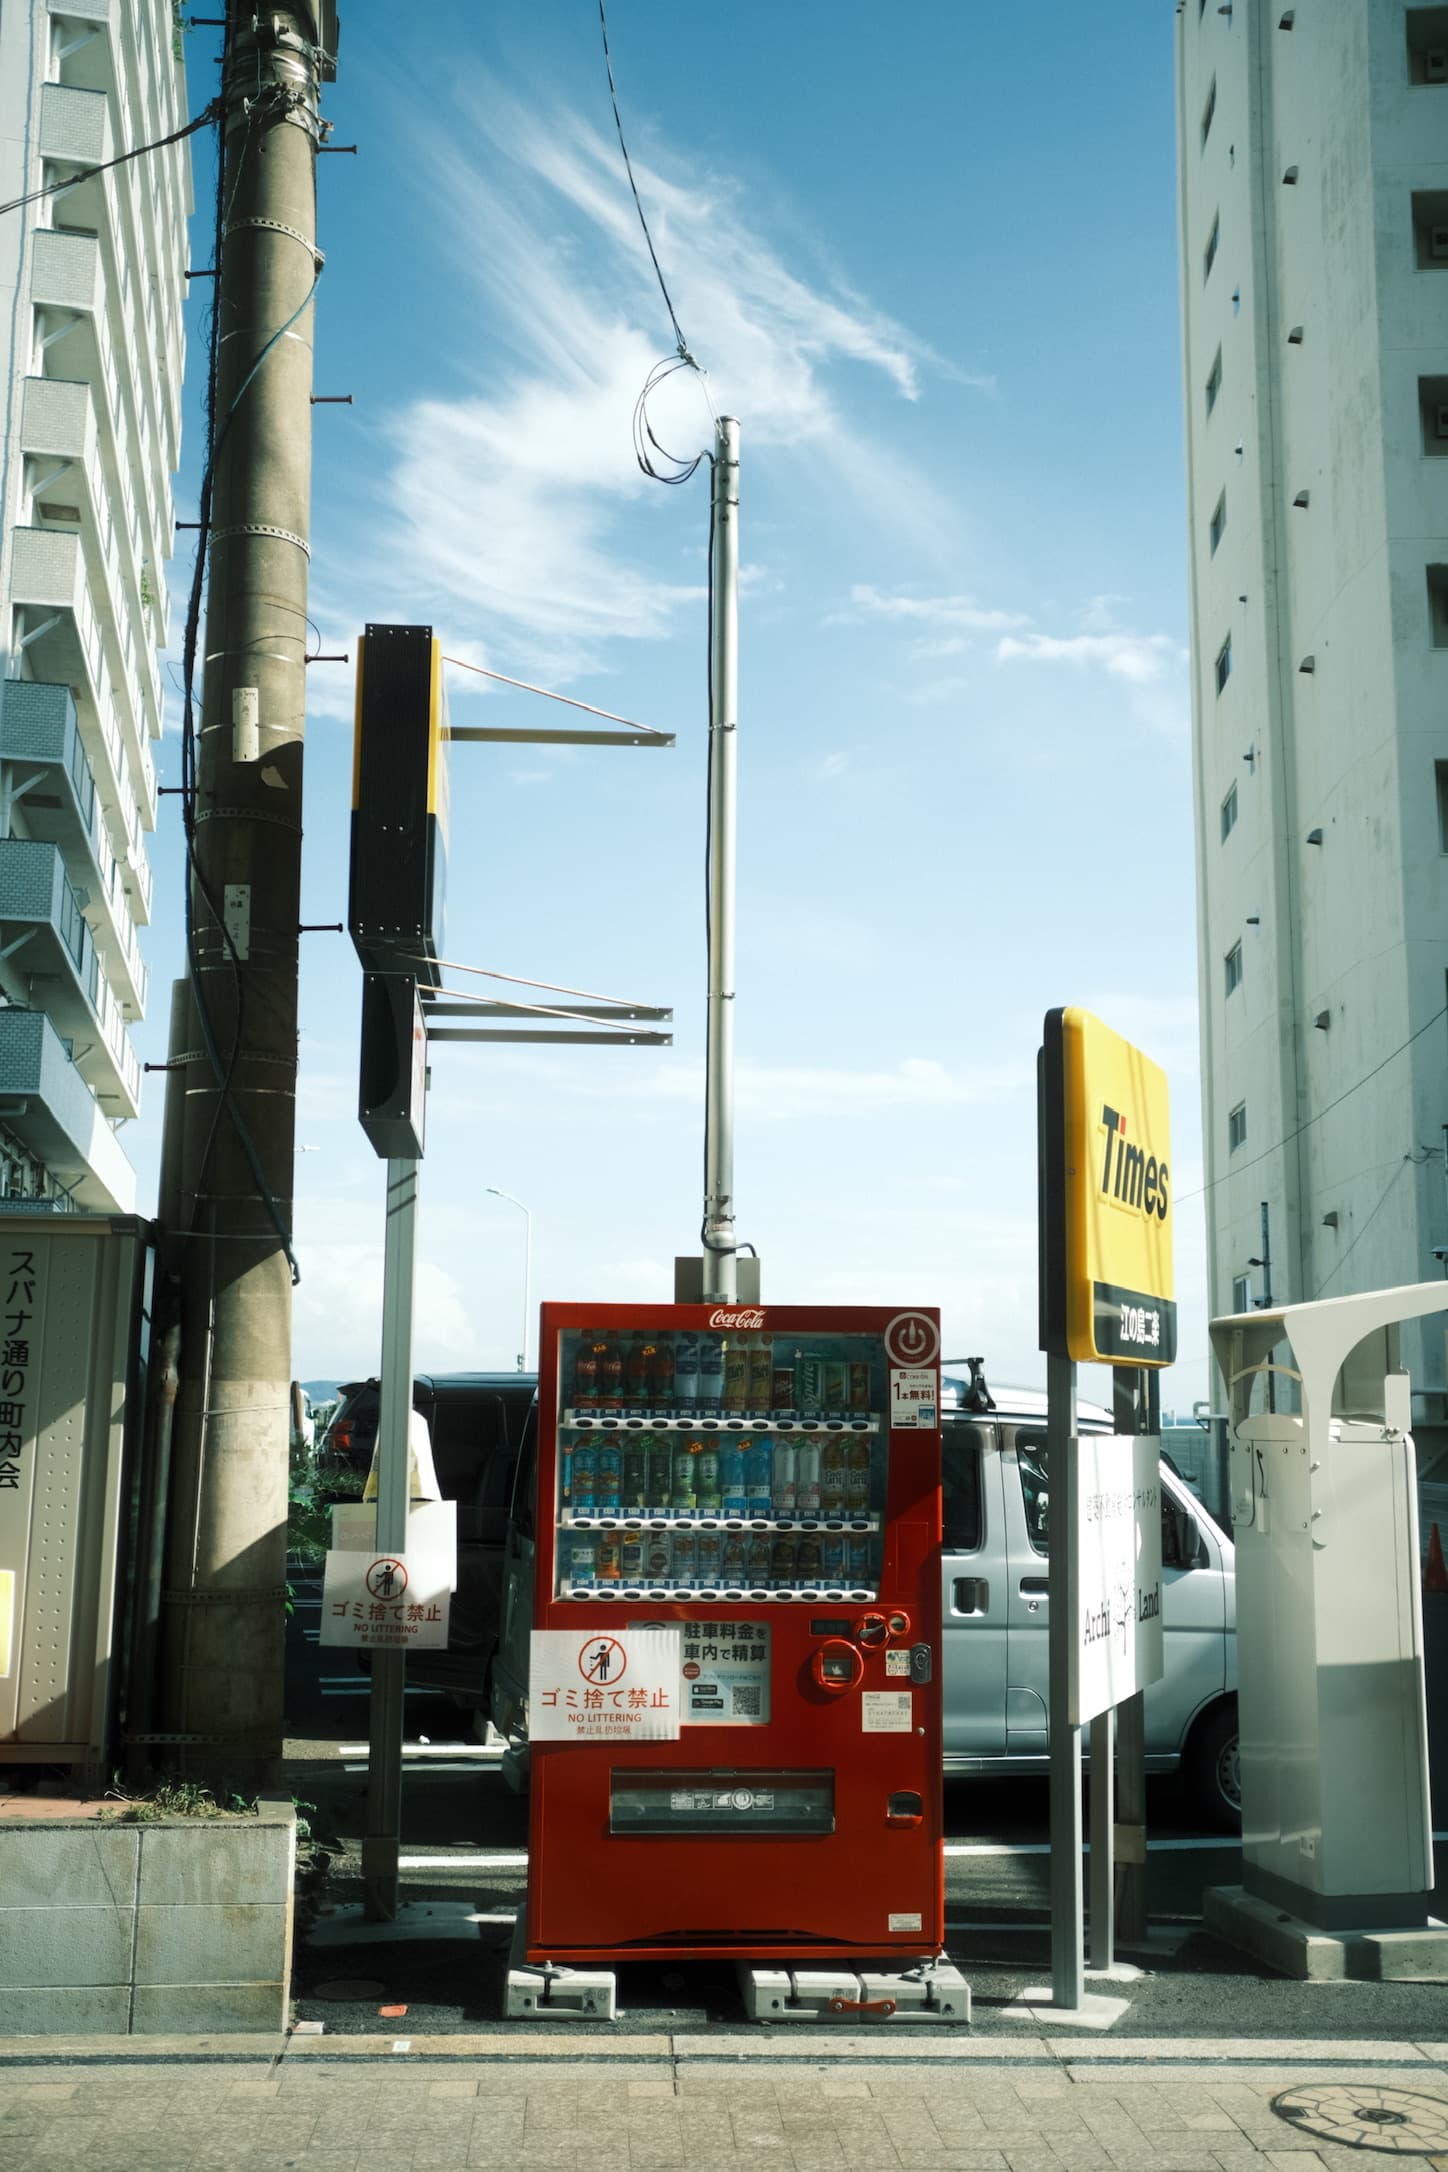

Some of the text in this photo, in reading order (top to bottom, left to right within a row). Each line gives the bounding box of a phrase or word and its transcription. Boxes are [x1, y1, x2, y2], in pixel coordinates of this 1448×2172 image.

[1102, 1104, 1168, 1221] Times
[709, 1309, 767, 1329] Coca-Cola
[332, 1601, 442, 1622] ゴミ捨て禁止
[1084, 1582, 1159, 1646] Archi Land
[354, 1623, 418, 1634] NO LITTERING
[684, 1622, 766, 1640] 駐車料金を
[684, 1643, 767, 1661] 車内で精算
[541, 1687, 671, 1710] ゴミ捨て禁止
[567, 1713, 642, 1723] NO LITTERING
